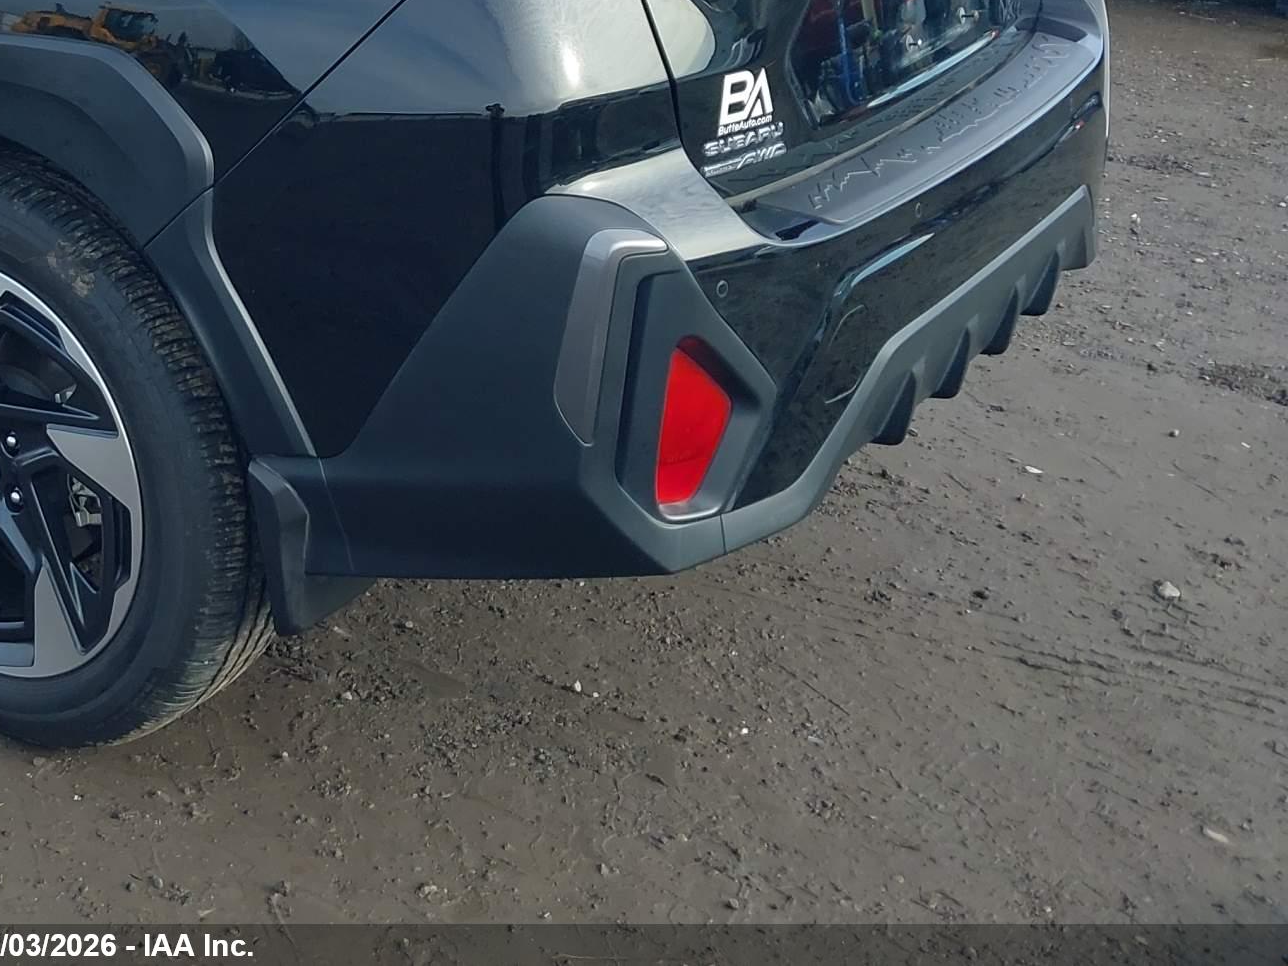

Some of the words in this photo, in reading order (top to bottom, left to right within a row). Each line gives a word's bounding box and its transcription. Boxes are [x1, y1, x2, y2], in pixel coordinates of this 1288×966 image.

[703, 121, 784, 156] SUBARU
[718, 114, 773, 137] ButteAuto.com
[737, 142, 787, 169] AWD
